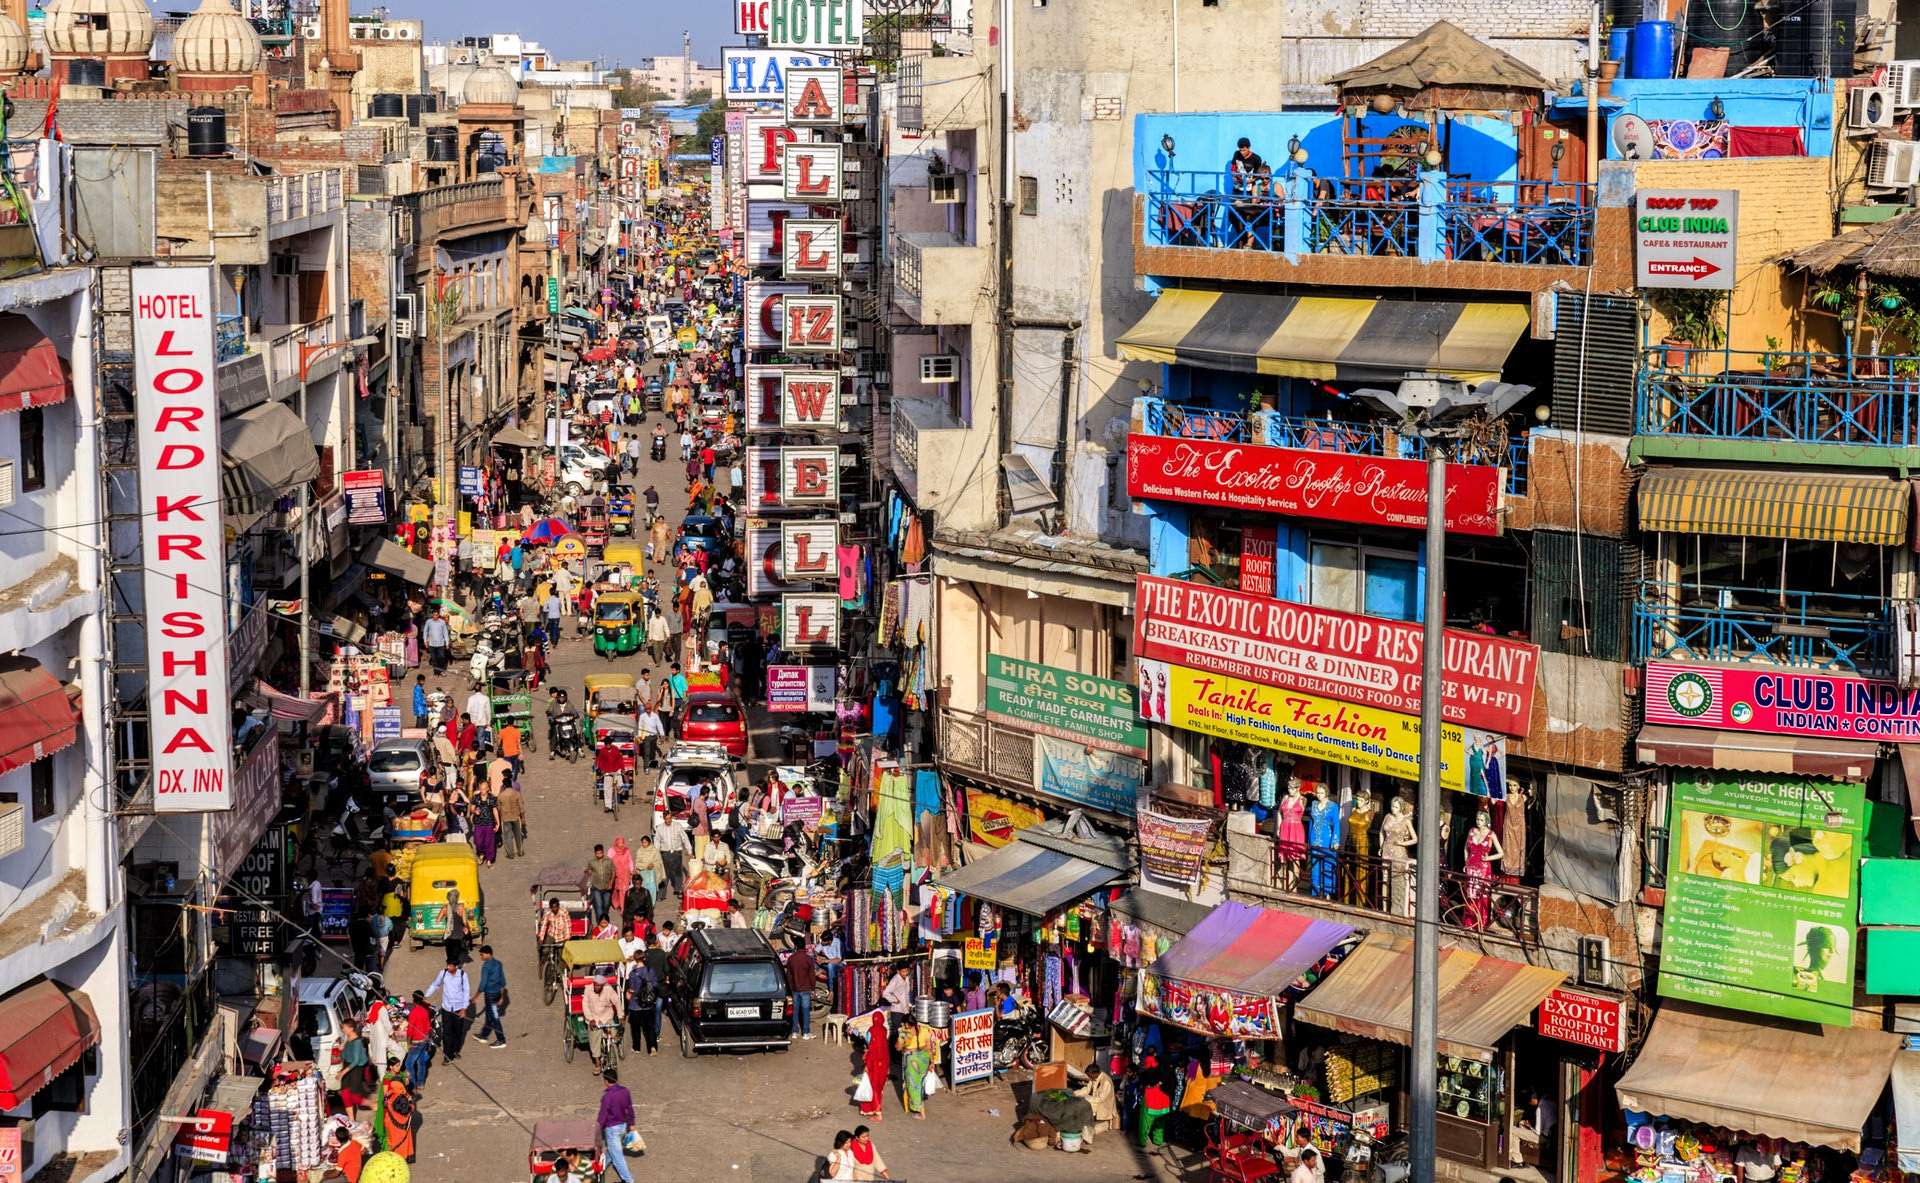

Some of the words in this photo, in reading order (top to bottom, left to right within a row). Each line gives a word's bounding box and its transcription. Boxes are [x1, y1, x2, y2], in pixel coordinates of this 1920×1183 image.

[771, 0, 861, 44] HOTEL
[1623, 131, 1640, 141] airtel
[1647, 197, 1686, 210] ROOF
[1689, 198, 1719, 210] TOP
[1639, 216, 1681, 233] CLUB
[1684, 217, 1729, 234] INDIA
[1673, 240, 1728, 249] RESTAURANT
[1650, 264, 1708, 273] ENTRANCE
[139, 295, 203, 320] HOTEL
[153, 330, 206, 471] LORD
[1163, 443, 1203, 478] The
[1204, 449, 1282, 490] Exotic
[1286, 456, 1352, 509] Rooftop
[1354, 464, 1459, 515] Restaurt
[1143, 483, 1173, 496] Delicious
[1174, 487, 1202, 498] Western
[1203, 490, 1220, 500] Food
[1228, 493, 1266, 508] Hospitality
[1267, 497, 1298, 510] Services
[1386, 513, 1428, 525] COMPLIMENT
[156, 494, 215, 755] KRISHNA
[1142, 581, 1183, 618] THE
[1187, 589, 1263, 635] EXOTIC
[1266, 605, 1372, 655] ROOFTOP
[1375, 624, 1532, 685] RESURANT
[778, 669, 799, 681] Дипак
[1146, 622, 1240, 655] BREAKFAST
[1243, 642, 1301, 668] LUNCH
[1323, 658, 1393, 687] DINNER
[1462, 684, 1521, 715] WI-FI)
[1186, 651, 1251, 677] REMEMBER
[1254, 664, 1269, 680] US
[1271, 671, 1295, 686] FOR
[1297, 676, 1365, 700] DELICIOUS
[1367, 689, 1403, 707] FOOD
[1001, 660, 1057, 688] HIRA
[1065, 675, 1133, 704] SONS
[1023, 683, 1057, 701] हीरा
[1754, 675, 1835, 712] CLUB
[999, 691, 1033, 709] READY
[1037, 699, 1068, 716] MADE
[1070, 708, 1133, 733] GARMENTS
[1193, 678, 1273, 716] Tanika
[1285, 697, 1388, 742] Fashion
[1413, 723, 1462, 743] 93192
[1777, 711, 1839, 732] INDIAN
[998, 714, 1042, 732] SUMMER
[1055, 728, 1096, 746] WINTER
[1099, 740, 1133, 754] WEAR
[1006, 706, 1013, 714] A
[1014, 708, 1061, 726] COMPLETE
[1064, 720, 1096, 735] FAMILY
[1098, 729, 1124, 741] SHOP
[1187, 703, 1210, 717] Deals
[1212, 708, 1222, 720] In:
[1226, 712, 1246, 726] High
[1248, 717, 1281, 733] Fashion
[1283, 725, 1314, 740] Sequins
[1316, 731, 1359, 750] Garments
[1361, 742, 1384, 757] Belly
[1385, 747, 1414, 763] Dance
[1212, 725, 1229, 735] Floor,
[1273, 738, 1287, 747] Main
[1289, 741, 1307, 753] Bazar,
[1308, 745, 1327, 757] Pahar
[1353, 756, 1379, 768] Delhi-55
[158, 769, 189, 794] DX.
[192, 768, 224, 793] INN
[1738, 779, 1775, 796] VEDIC
[1724, 792, 1769, 803] AYURVEDIC
[1773, 798, 1810, 809] THERAPY
[1682, 896, 1712, 908] Pharmacy
[1722, 903, 1740, 912] Herbs
[1684, 877, 1712, 888] Ayurvedic
[1749, 887, 1777, 899] Therapies
[1807, 897, 1846, 909] Consultation
[241, 926, 274, 938] FREE
[1680, 917, 1699, 926] Aroma
[1699, 920, 1711, 929] Oils
[1717, 924, 1736, 933] Herbal
[1762, 931, 1774, 939] Oils
[242, 941, 274, 953] WI-FI
[1694, 939, 1723, 951] Ayurvedic
[1724, 944, 1749, 956] Courses
[1755, 950, 1789, 962] Workshops
[1674, 955, 1706, 968] Sovereign
[1713, 962, 1738, 974] Special
[1738, 966, 1754, 976] Gifts
[1560, 992, 1590, 1004] WELCOME
[1591, 998, 1600, 1006] TO
[1544, 997, 1616, 1027] EXOTIC
[954, 1017, 973, 1037] HIRA
[973, 1013, 993, 1032] SONS
[1543, 1023, 1615, 1049] RESTAURANT
[1551, 1014, 1608, 1036] ROOFTOP
[955, 1036, 975, 1054] हीरा
[976, 1032, 993, 1049] संस
